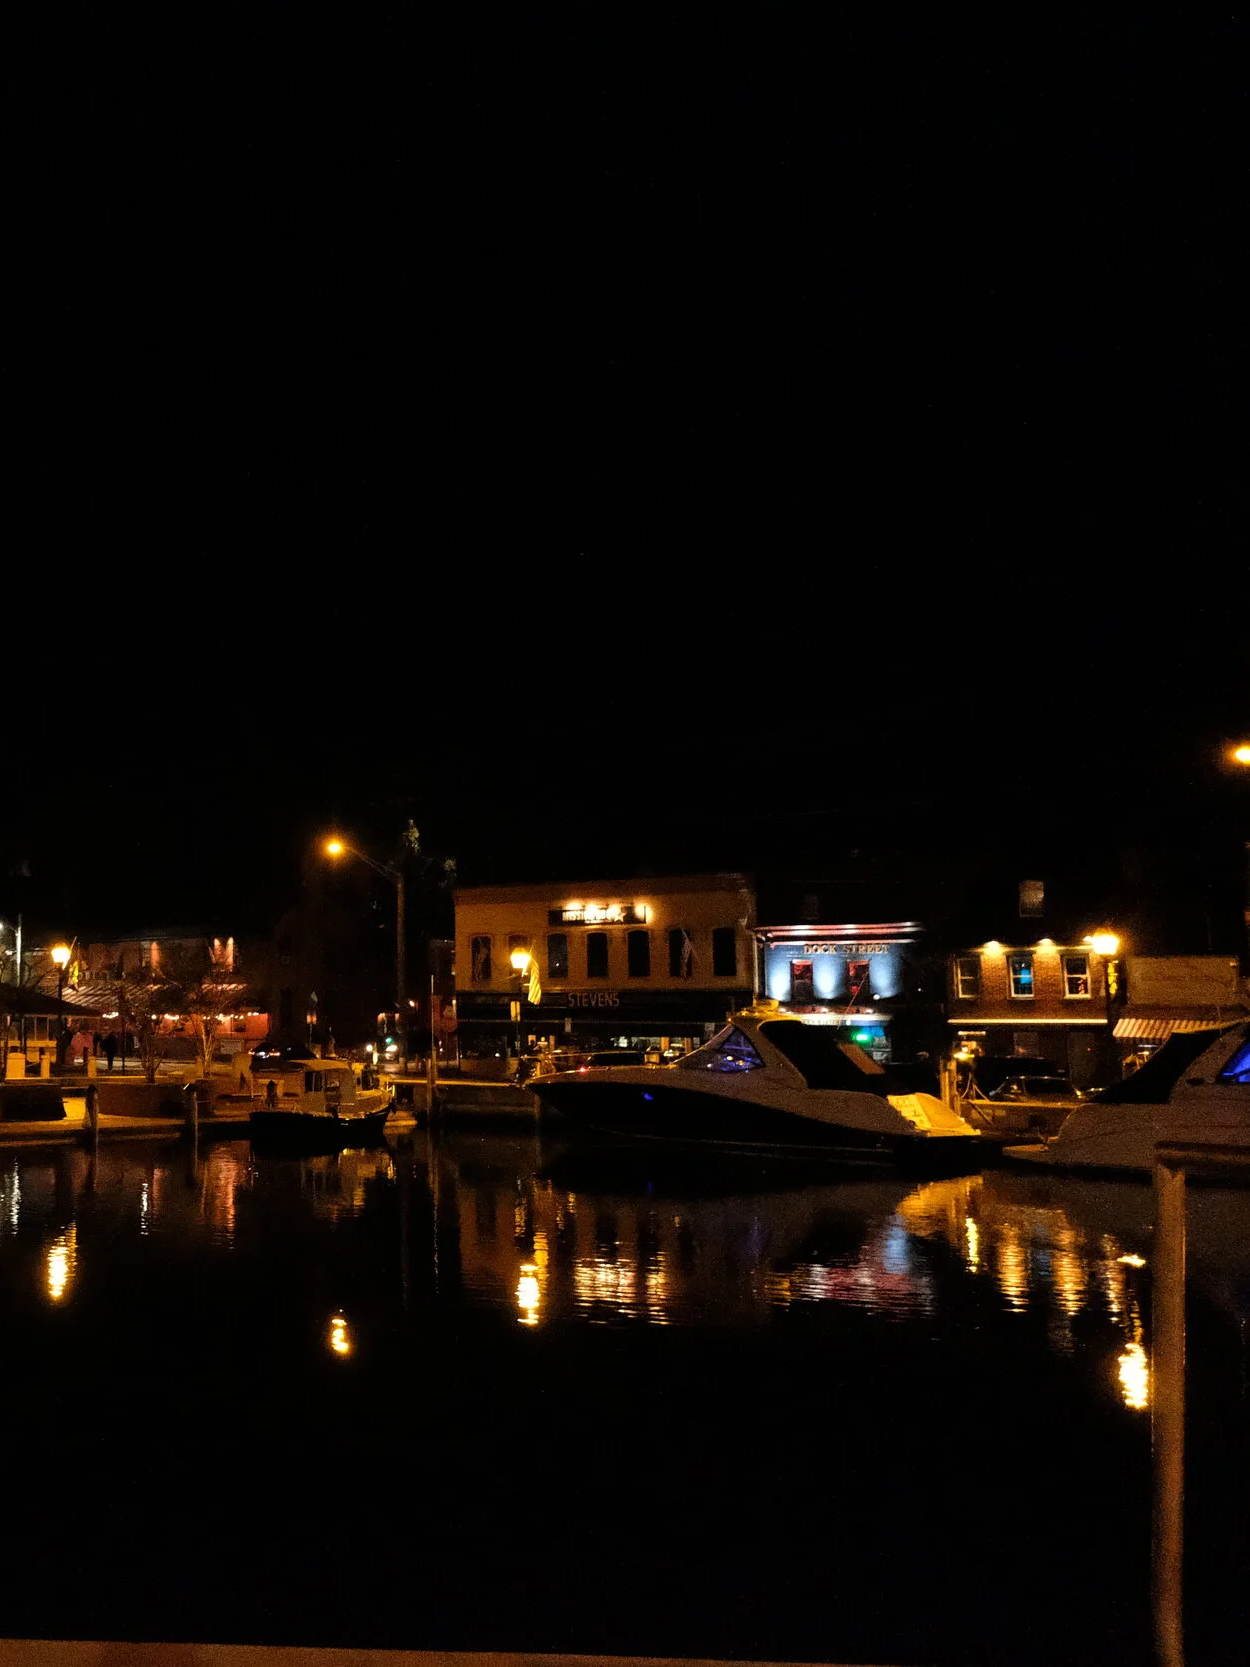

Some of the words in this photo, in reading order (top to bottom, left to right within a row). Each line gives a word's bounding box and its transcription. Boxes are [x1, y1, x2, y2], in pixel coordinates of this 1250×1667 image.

[803, 944, 837, 955] DOCK
[842, 943, 889, 955] STREET
[568, 992, 620, 1009] STEVENS
